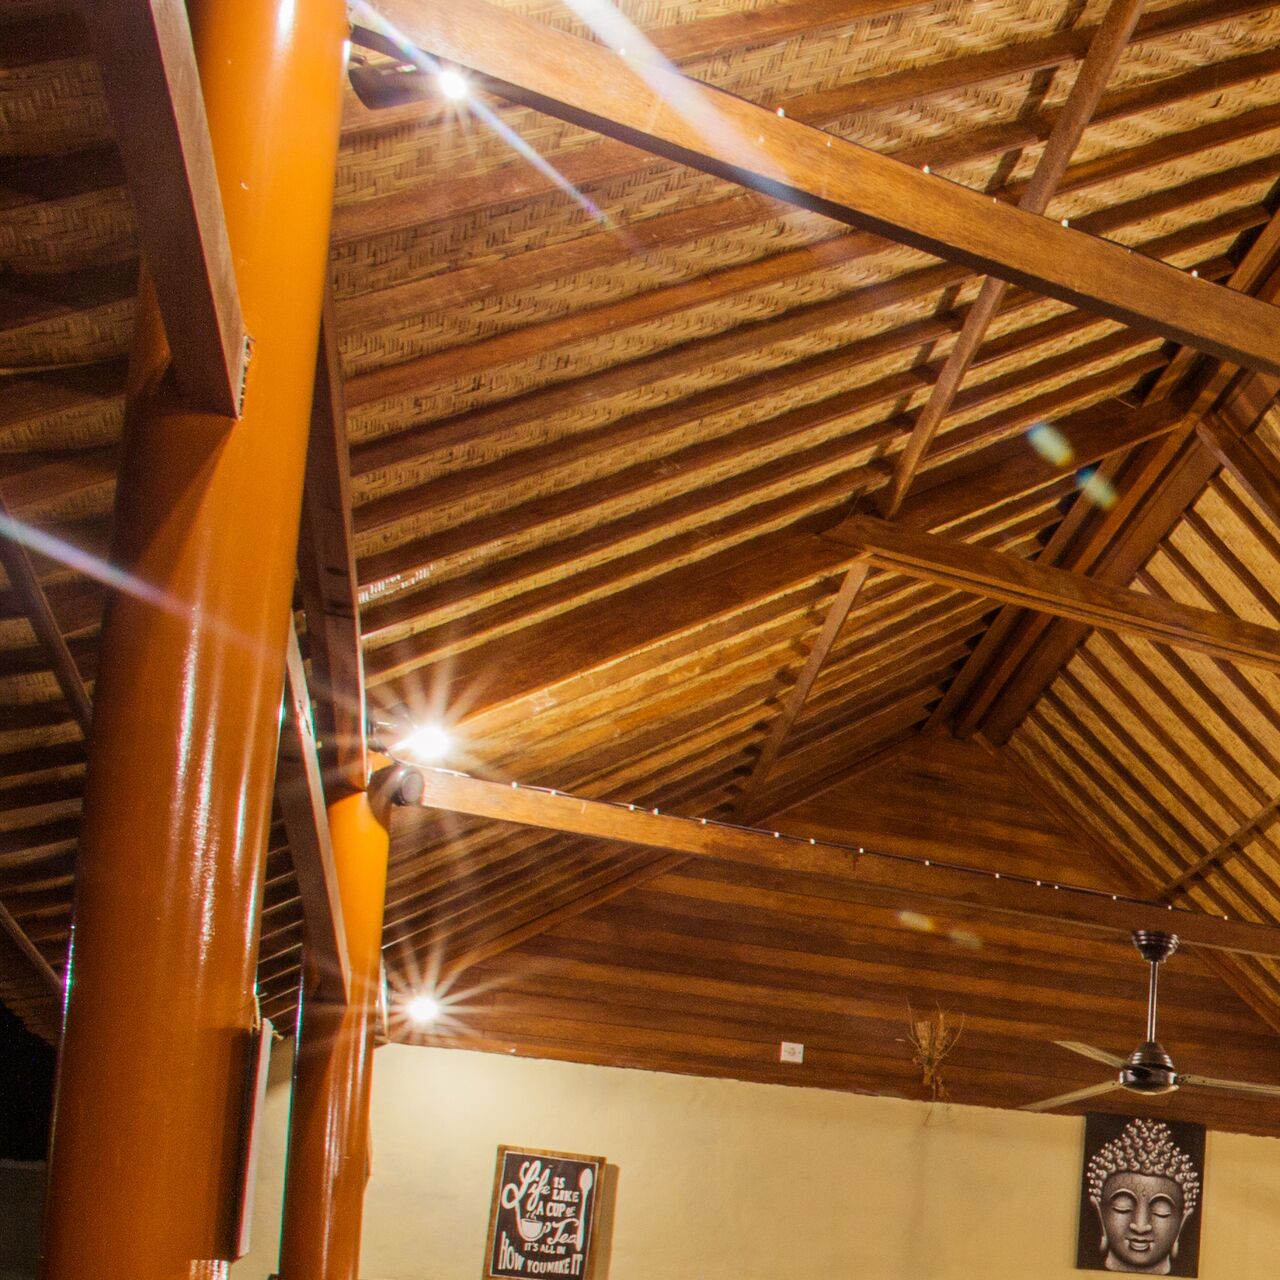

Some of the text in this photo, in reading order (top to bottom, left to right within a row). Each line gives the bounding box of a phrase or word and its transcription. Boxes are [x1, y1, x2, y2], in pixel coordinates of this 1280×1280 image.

[502, 1160, 566, 1212] Life IS
[552, 1189, 580, 1202] LIKE
[536, 1201, 545, 1215] A
[546, 1201, 567, 1217] CUP
[547, 1218, 580, 1245] Tea
[498, 1231, 583, 1275] HOW YOU MAKE IT
[524, 1243, 566, 1254] IT'S ALL IN
